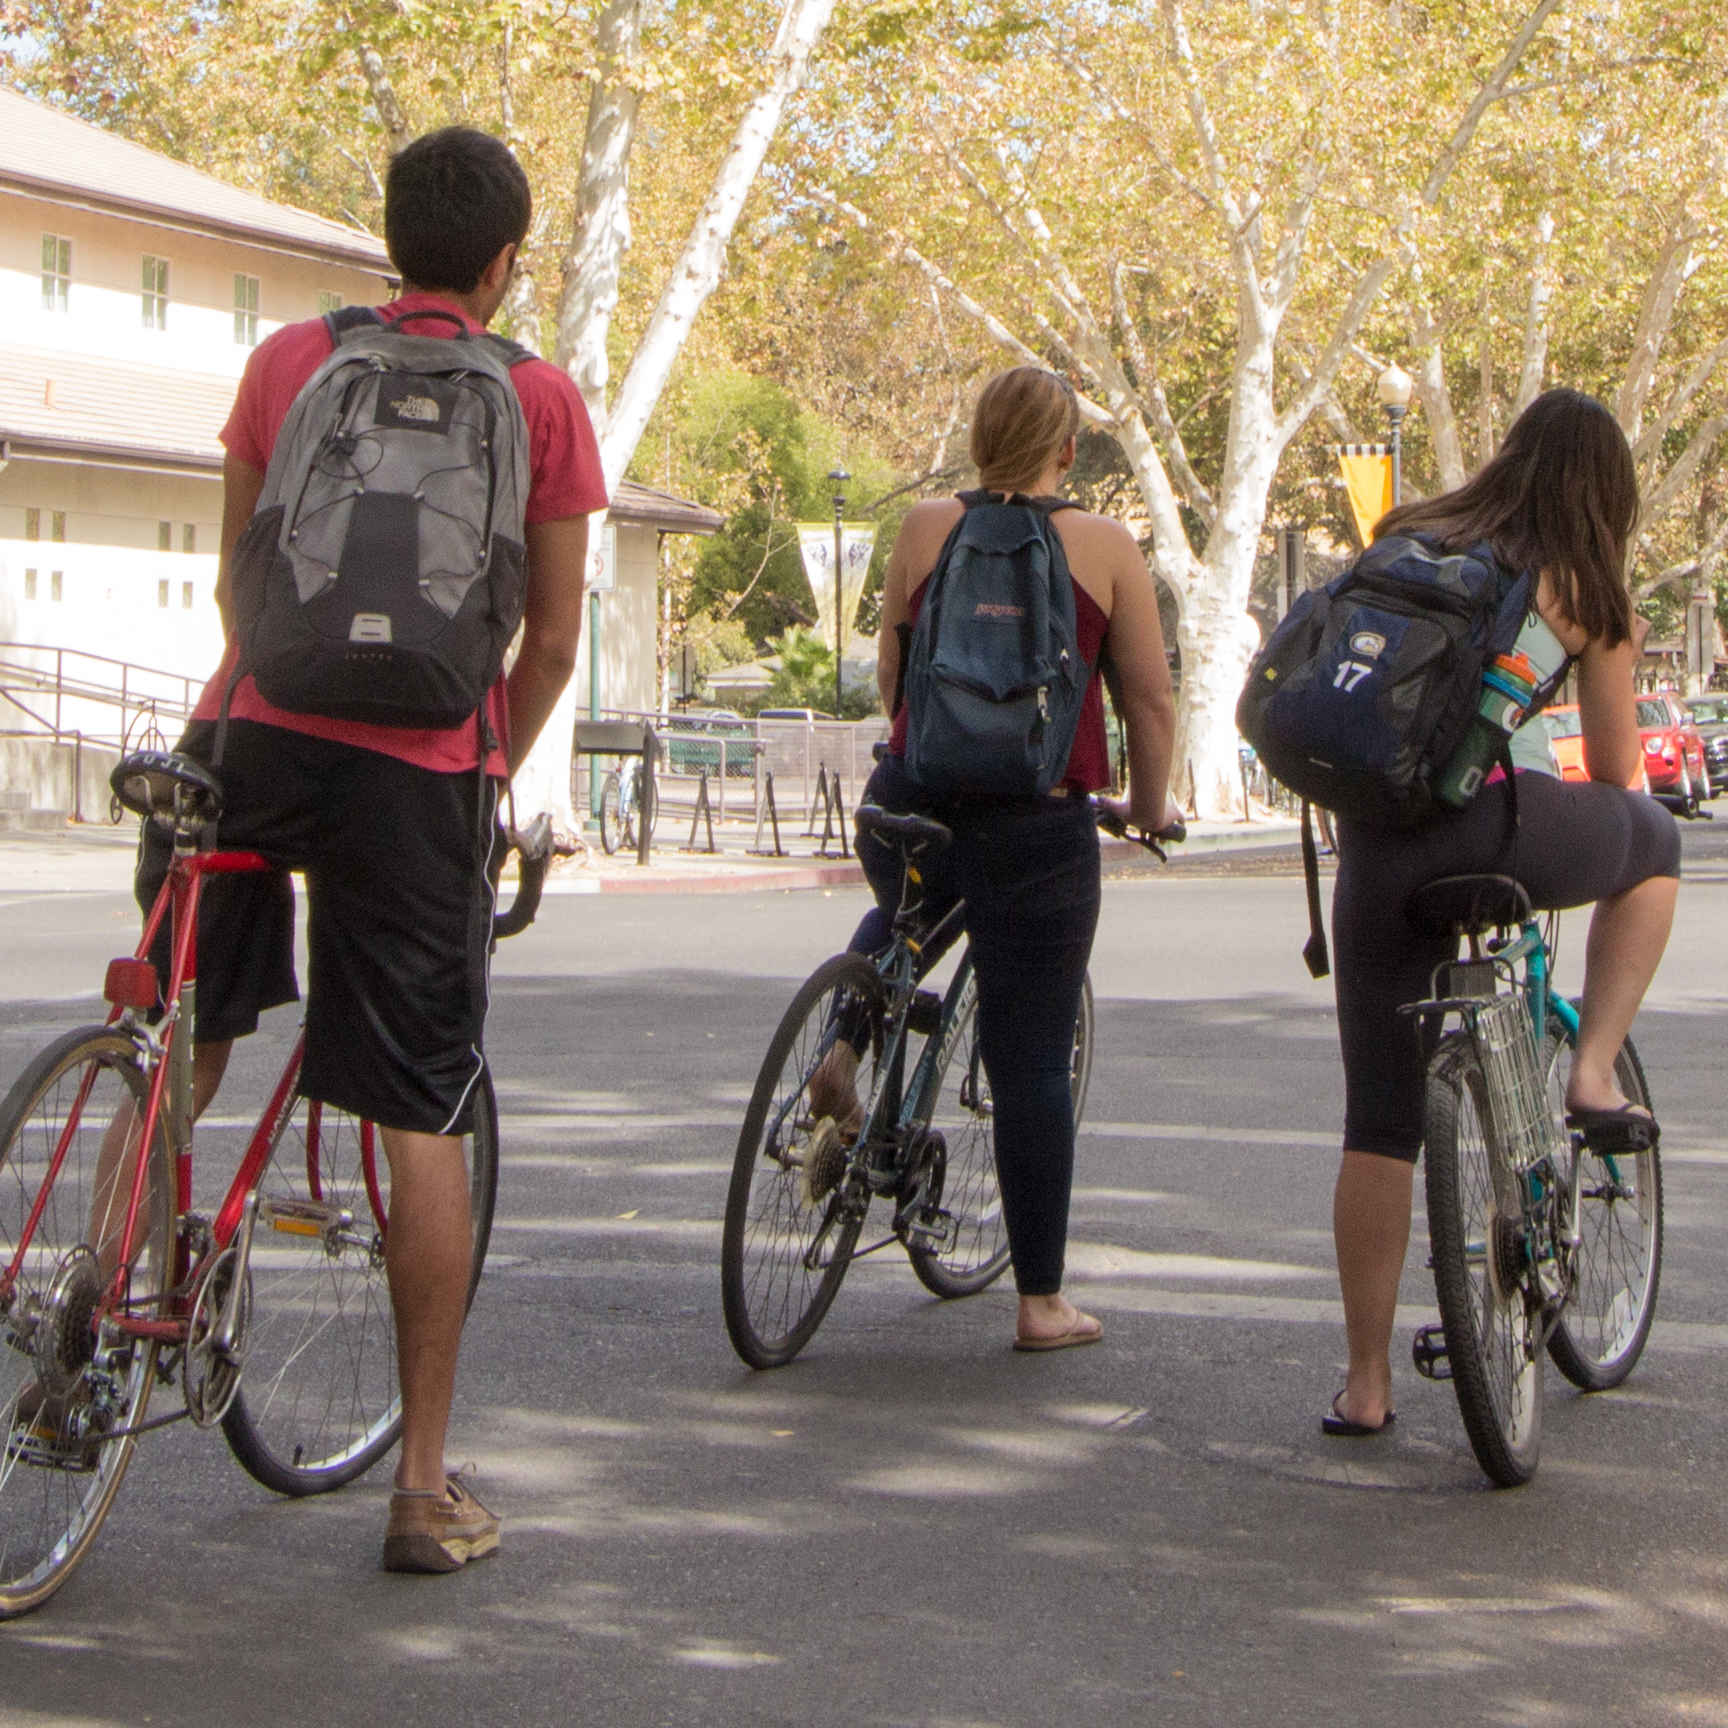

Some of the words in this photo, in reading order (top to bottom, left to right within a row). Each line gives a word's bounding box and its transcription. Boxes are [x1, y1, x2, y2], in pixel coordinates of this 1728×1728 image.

[1333, 660, 1372, 692] 17
[128, 754, 184, 773] FUJI
[936, 969, 977, 1074] RALEIG
